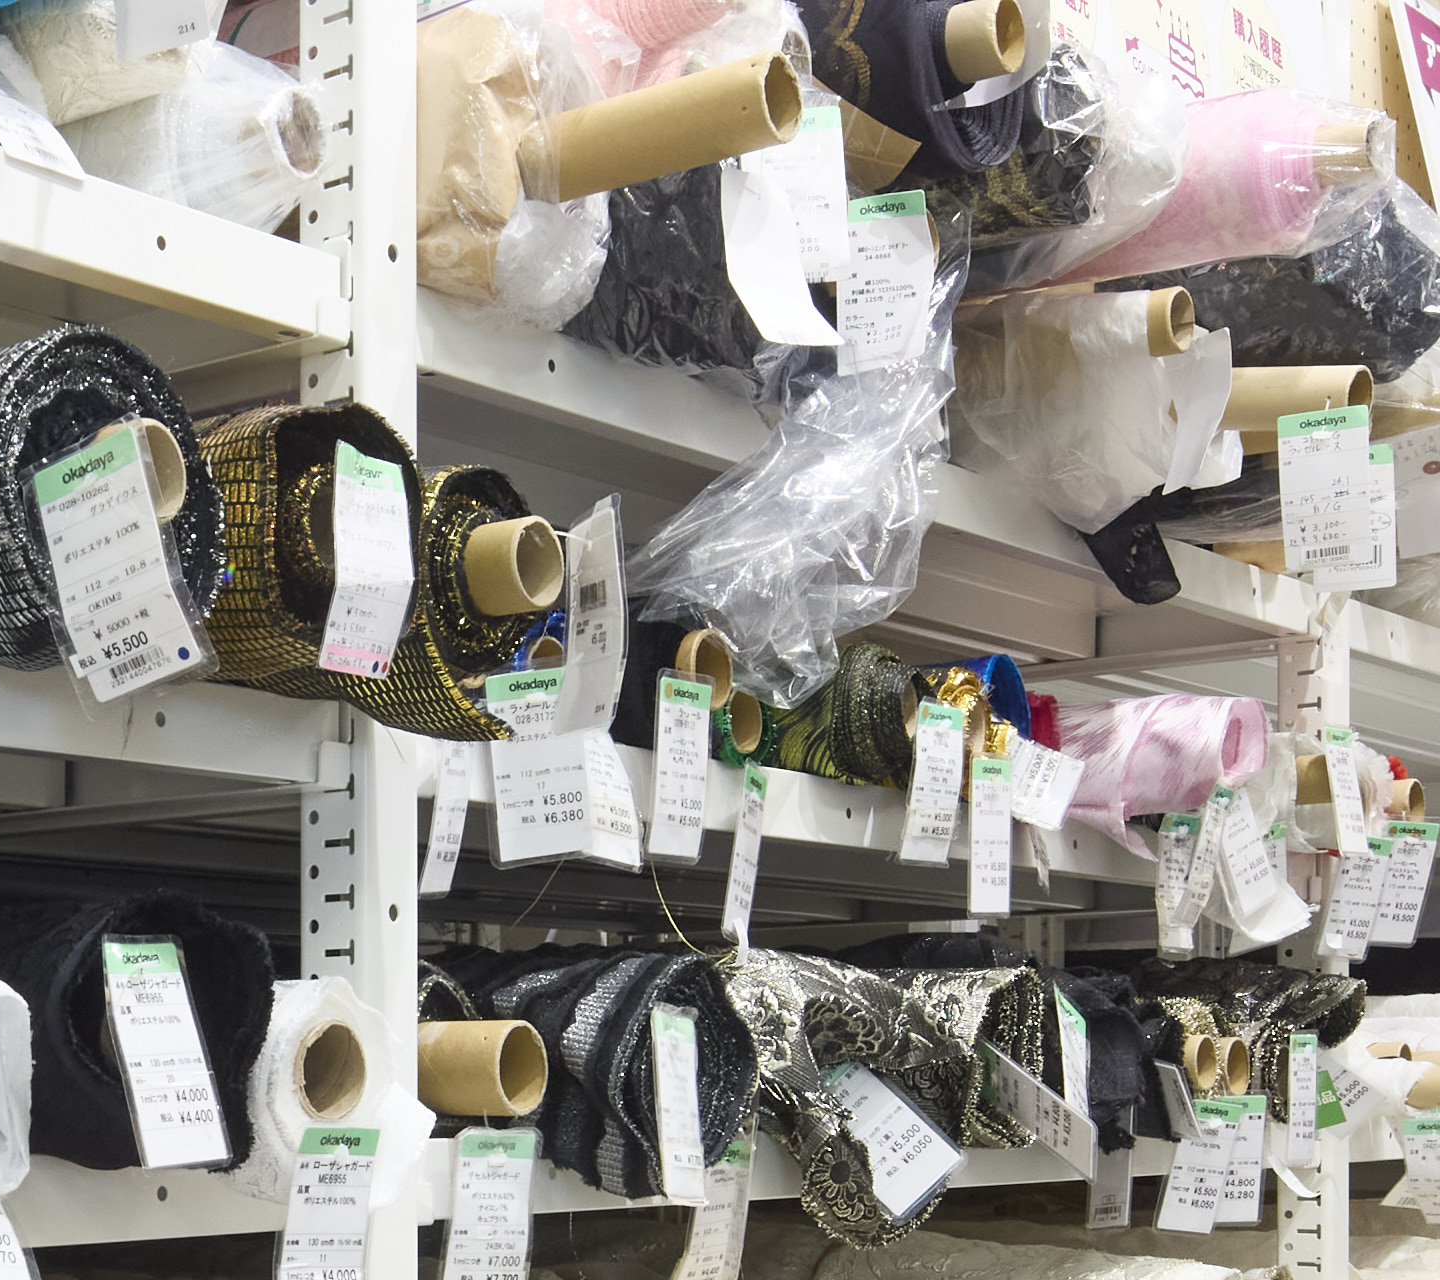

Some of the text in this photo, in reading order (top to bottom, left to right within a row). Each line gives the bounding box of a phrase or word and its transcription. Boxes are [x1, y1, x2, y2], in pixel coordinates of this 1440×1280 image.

[178, 23, 196, 34] 214
[62, 450, 115, 485] okadaya
[116, 522, 140, 539] 100%
[102, 631, 148, 660] ¥5,500
[509, 677, 557, 693] okadaya
[543, 791, 583, 806] ¥5,800
[544, 808, 584, 823] ¥6,380
[127, 978, 181, 989] ローザジャガード
[175, 1088, 209, 1102] ¥4,000
[179, 1109, 213, 1124] ¥4,400
[320, 1134, 360, 1148] okadaya
[318, 1174, 346, 1184] ME6955
[488, 1255, 521, 1268] ¥7,000
